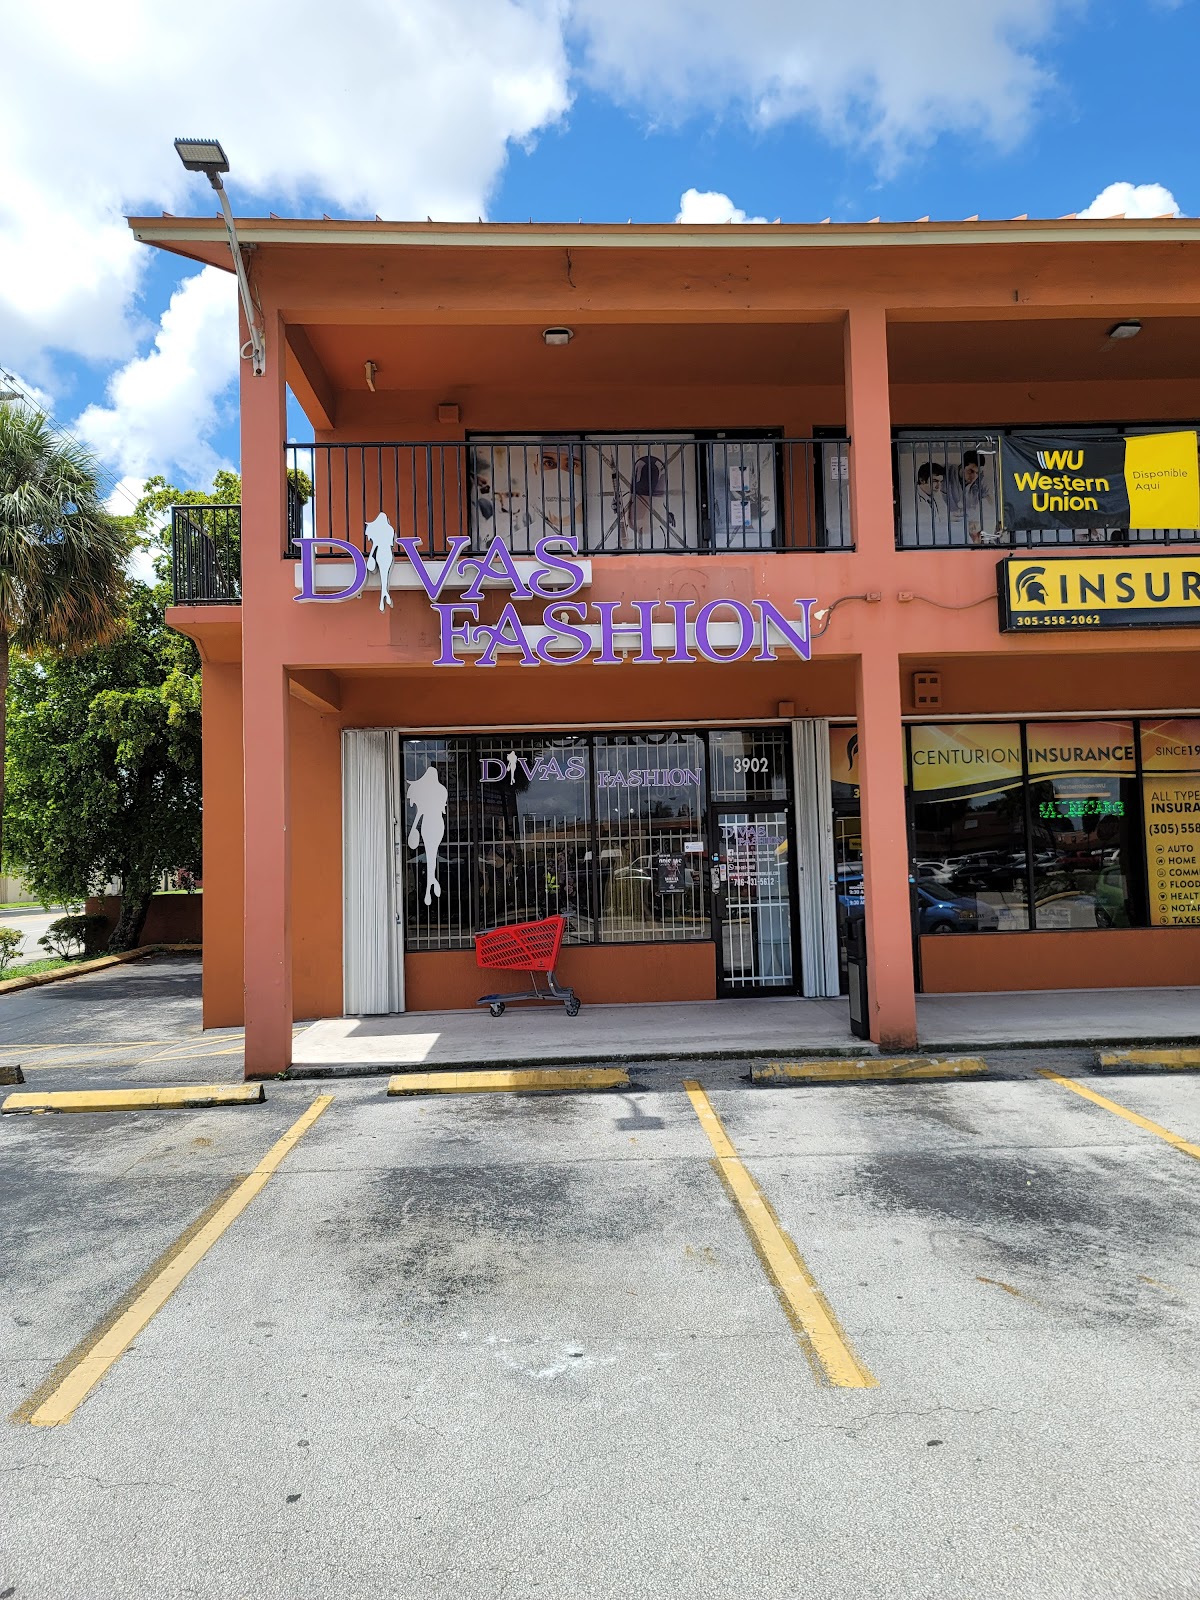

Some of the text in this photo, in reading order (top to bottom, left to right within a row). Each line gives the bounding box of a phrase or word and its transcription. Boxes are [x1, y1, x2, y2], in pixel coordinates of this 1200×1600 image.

[1037, 450, 1085, 471] WU
[1133, 468, 1188, 480] Disponible
[1014, 472, 1110, 492] Western
[1032, 491, 1099, 512] Union
[1017, 615, 1100, 626] 305-558-2062
[431, 598, 818, 668] FASHION
[913, 745, 1135, 766] CENTURION INSURANCE
[733, 757, 769, 773] 3902
[597, 768, 702, 788] FASHION
[1151, 791, 1171, 802] ALL
[1167, 844, 1194, 853] AUTO
[1168, 856, 1197, 865] HOME
[1169, 868, 1200, 877] COMM
[1170, 880, 1200, 889] FLOOD
